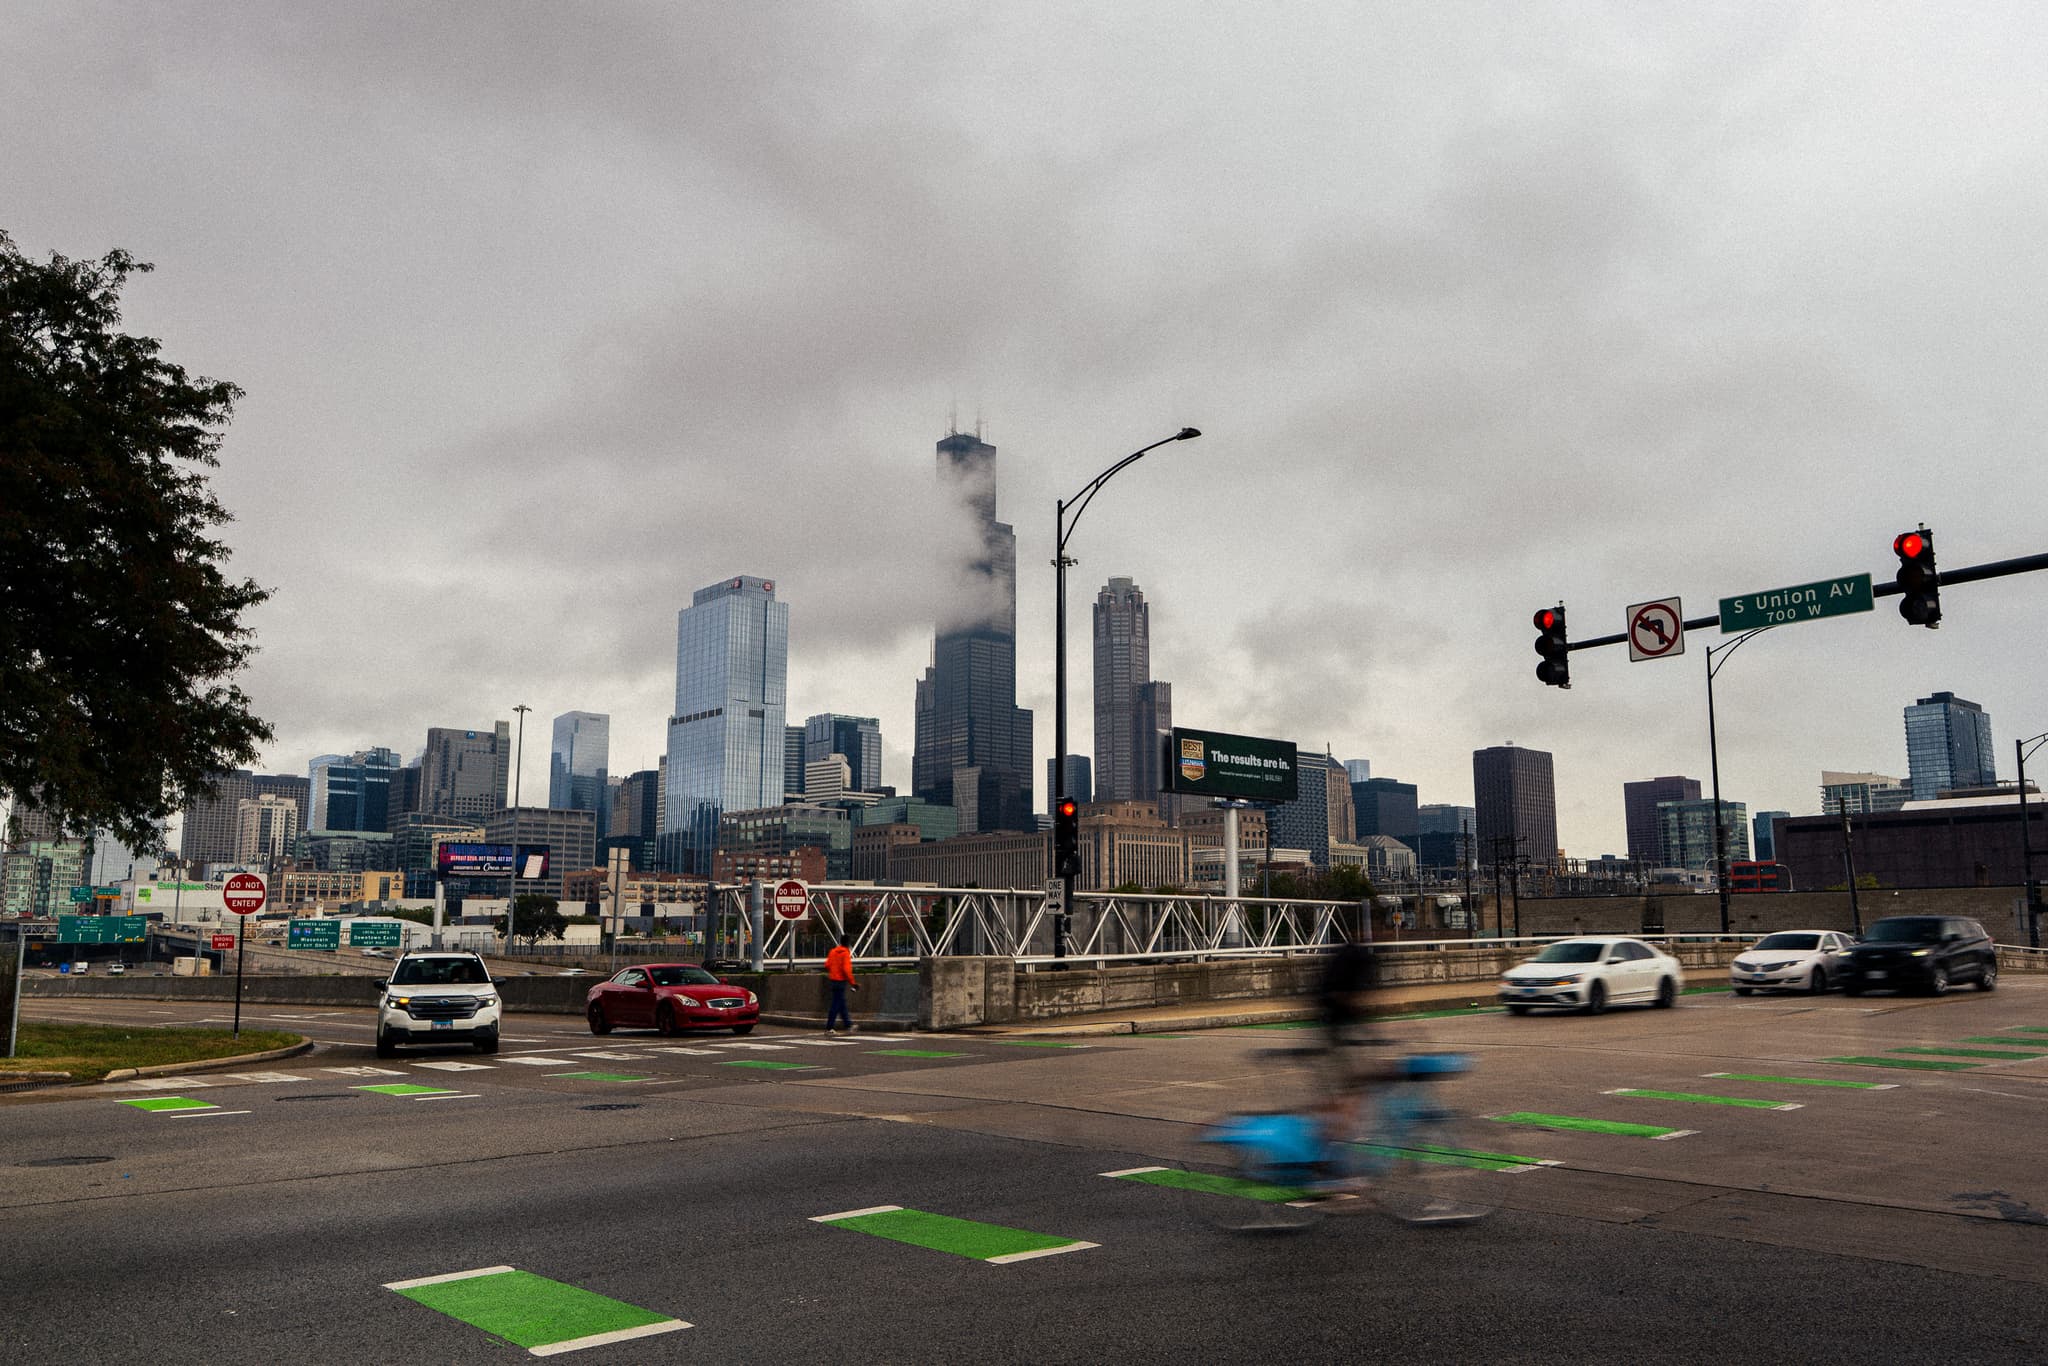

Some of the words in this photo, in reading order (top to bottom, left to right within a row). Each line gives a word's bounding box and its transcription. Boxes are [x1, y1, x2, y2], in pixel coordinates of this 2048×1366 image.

[1734, 599, 1744, 614] S
[1756, 588, 1816, 610] Union
[1829, 582, 1855, 598] Av
[1766, 608, 1796, 623] 700
[1808, 604, 1822, 616] W
[1211, 750, 1229, 763] The
[1230, 754, 1262, 767] results
[1263, 759, 1278, 769] are
[1279, 758, 1290, 770] in.
[230, 881, 241, 889] DO
[245, 881, 260, 889] NOT
[1048, 881, 1062, 890] ONE
[778, 888, 788, 896] DO
[790, 888, 803, 896] NOT
[1048, 890, 1062, 899] WAY
[231, 899, 257, 907] ENTER
[781, 904, 801, 912] ENTER
